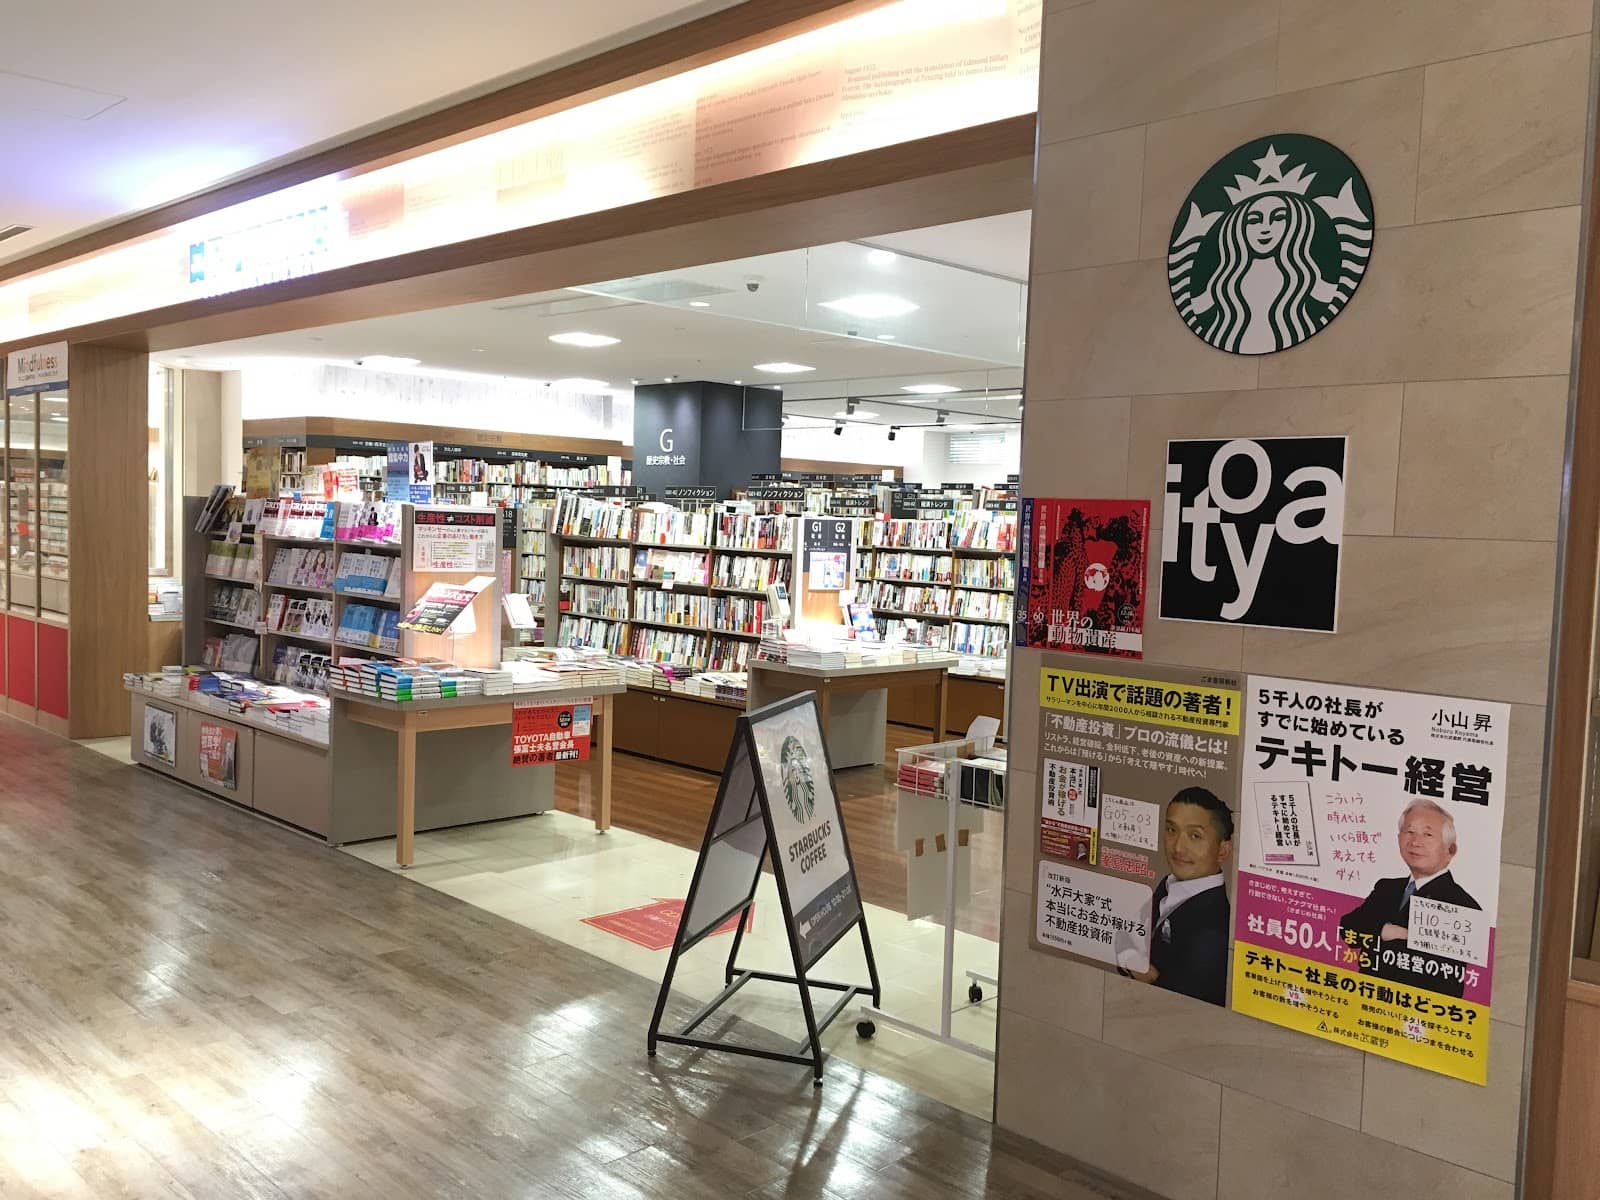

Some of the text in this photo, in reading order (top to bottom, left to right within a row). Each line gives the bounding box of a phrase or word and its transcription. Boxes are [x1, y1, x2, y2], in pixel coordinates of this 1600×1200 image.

[659, 428, 674, 452] G
[678, 488, 715, 497] ノンフィクション
[762, 489, 804, 498] ノンフィクション
[1051, 609, 1094, 632] 世界の
[1047, 674, 1232, 716] TV出演で話題の著者!
[1258, 688, 1384, 719] 5千人の社長が
[1257, 710, 1405, 746] すでに始めている
[789, 820, 832, 864] STARBUCKS
[800, 843, 828, 875] COFFEE
[1045, 914, 1113, 945] 不動産投資術
[1046, 899, 1146, 937] 本当にお金が稼げる
